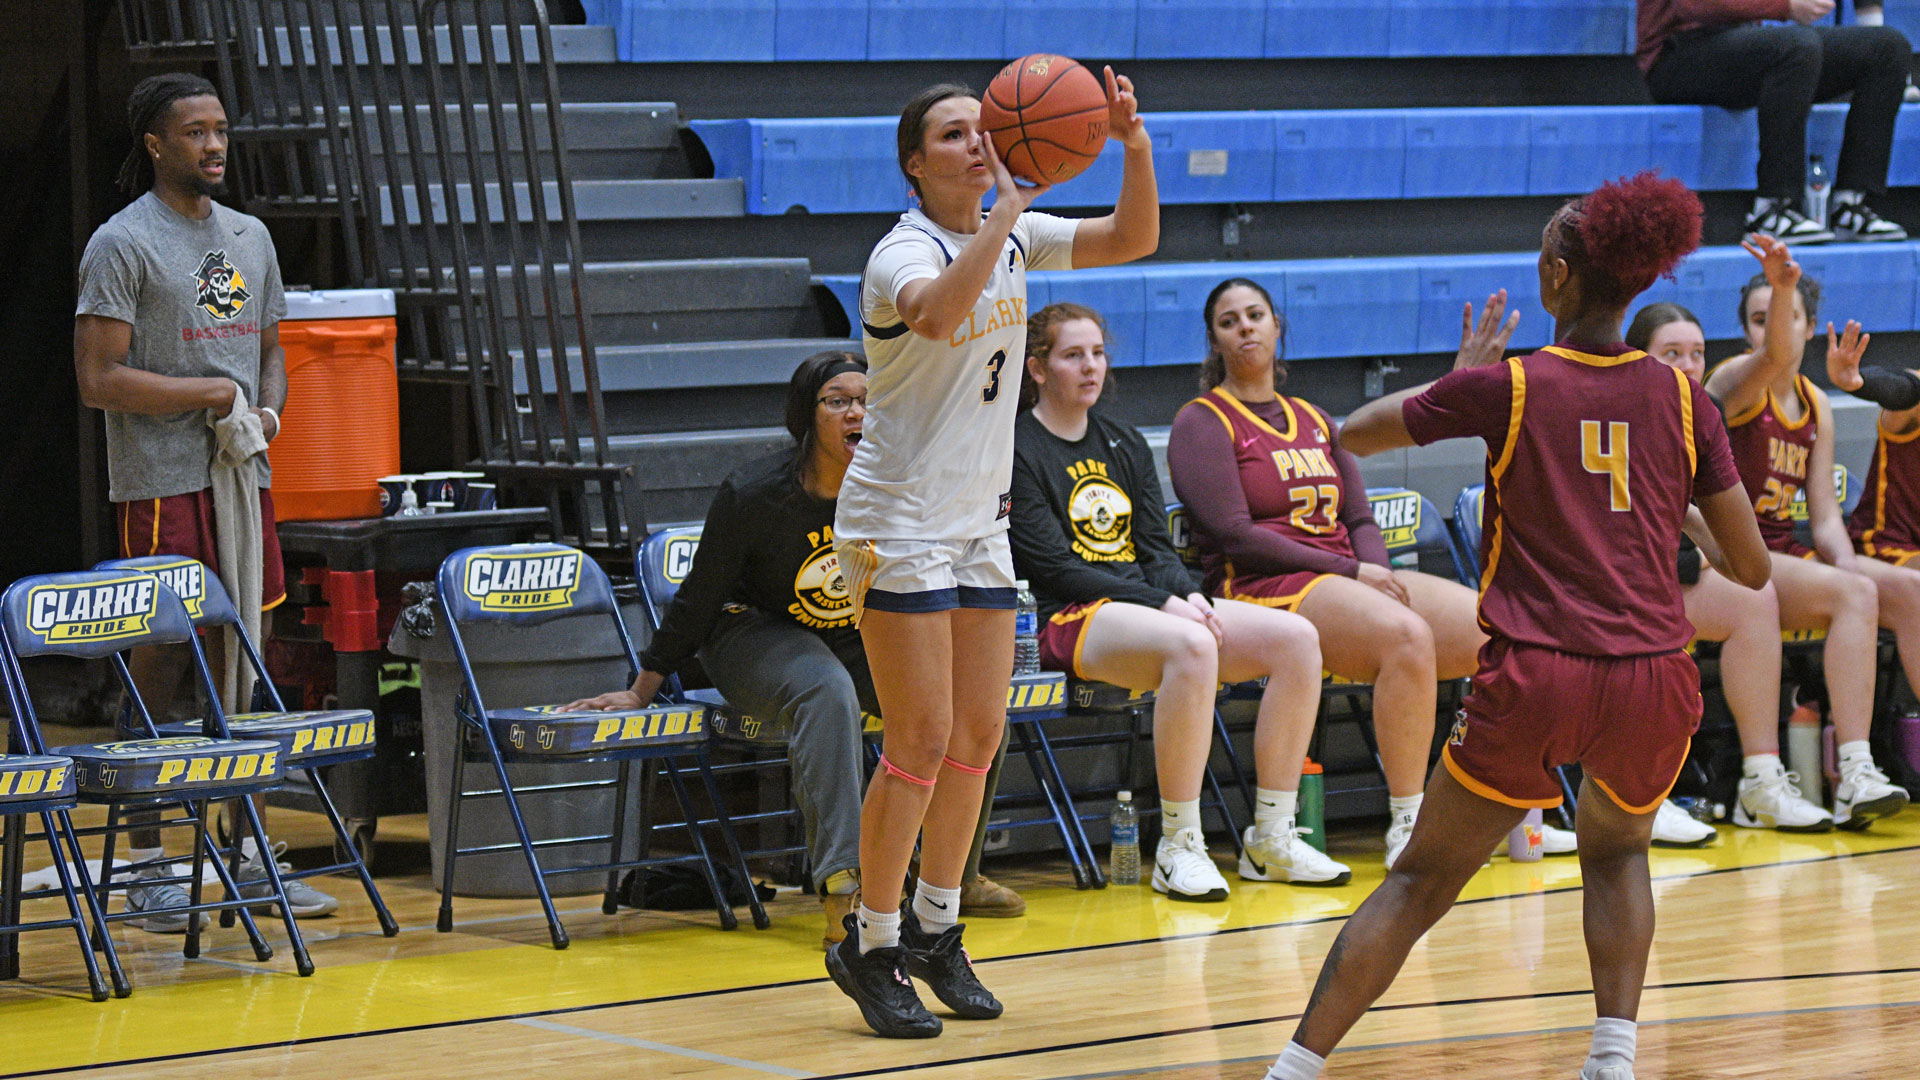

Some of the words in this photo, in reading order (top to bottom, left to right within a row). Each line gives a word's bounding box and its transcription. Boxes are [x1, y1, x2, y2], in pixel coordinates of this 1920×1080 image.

[950, 297, 1027, 348] CLARK
[981, 346, 1008, 405] 3
[1066, 458, 1108, 481] PARK
[1271, 448, 1337, 481] PARK
[1581, 420, 1631, 512] 4
[1769, 437, 1809, 480] PARK
[1288, 484, 1339, 535] 23
[469, 554, 577, 595] CLARKE
[31, 580, 153, 630] CLARKE
[500, 592, 552, 605] PRIDE
[67, 619, 127, 636] PRIDE
[290, 720, 375, 754] PRIDE
[592, 710, 703, 743] PRIDE
[155, 751, 278, 785] PRIDE
